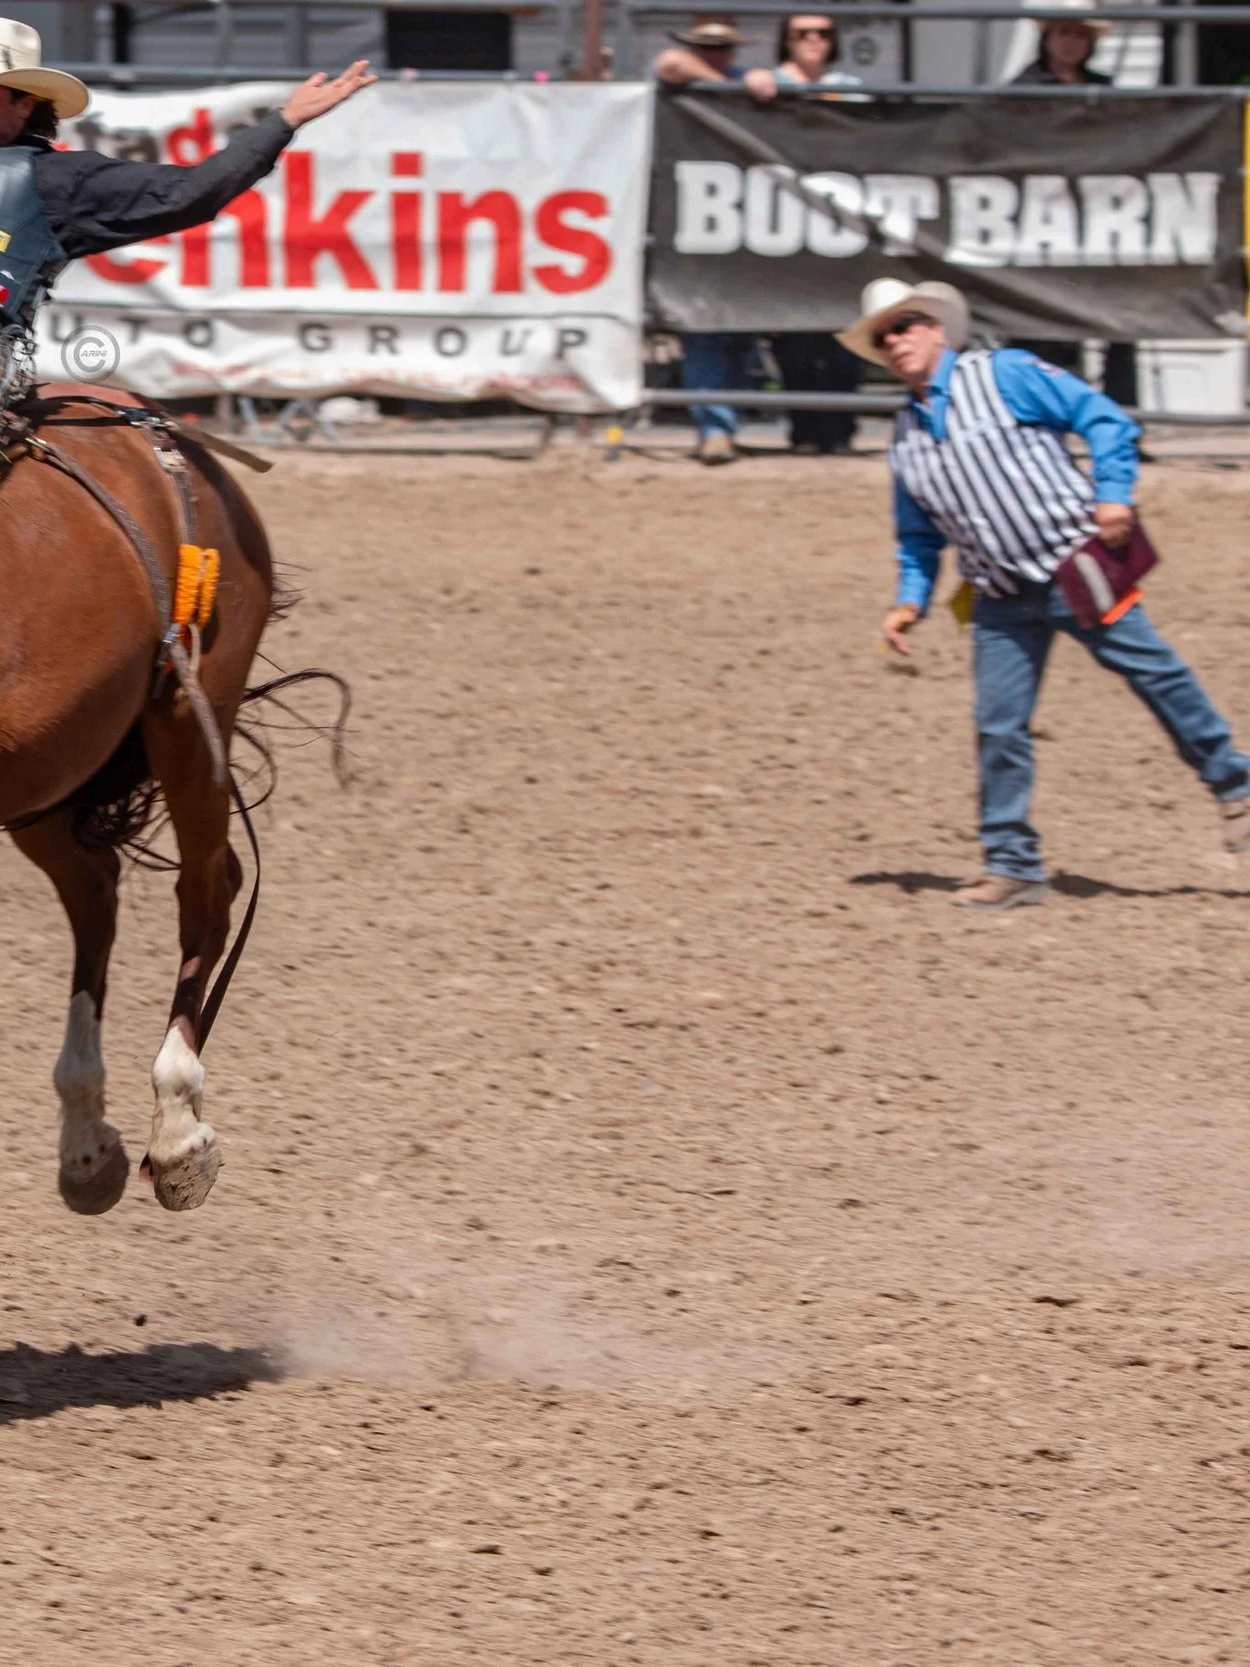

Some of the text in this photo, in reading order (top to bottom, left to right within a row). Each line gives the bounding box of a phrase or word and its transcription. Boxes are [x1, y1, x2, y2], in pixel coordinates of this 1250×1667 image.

[53, 143, 614, 295] nkins
[674, 161, 1222, 267] BOOT BARN
[51, 313, 588, 361] UTO GROUP
